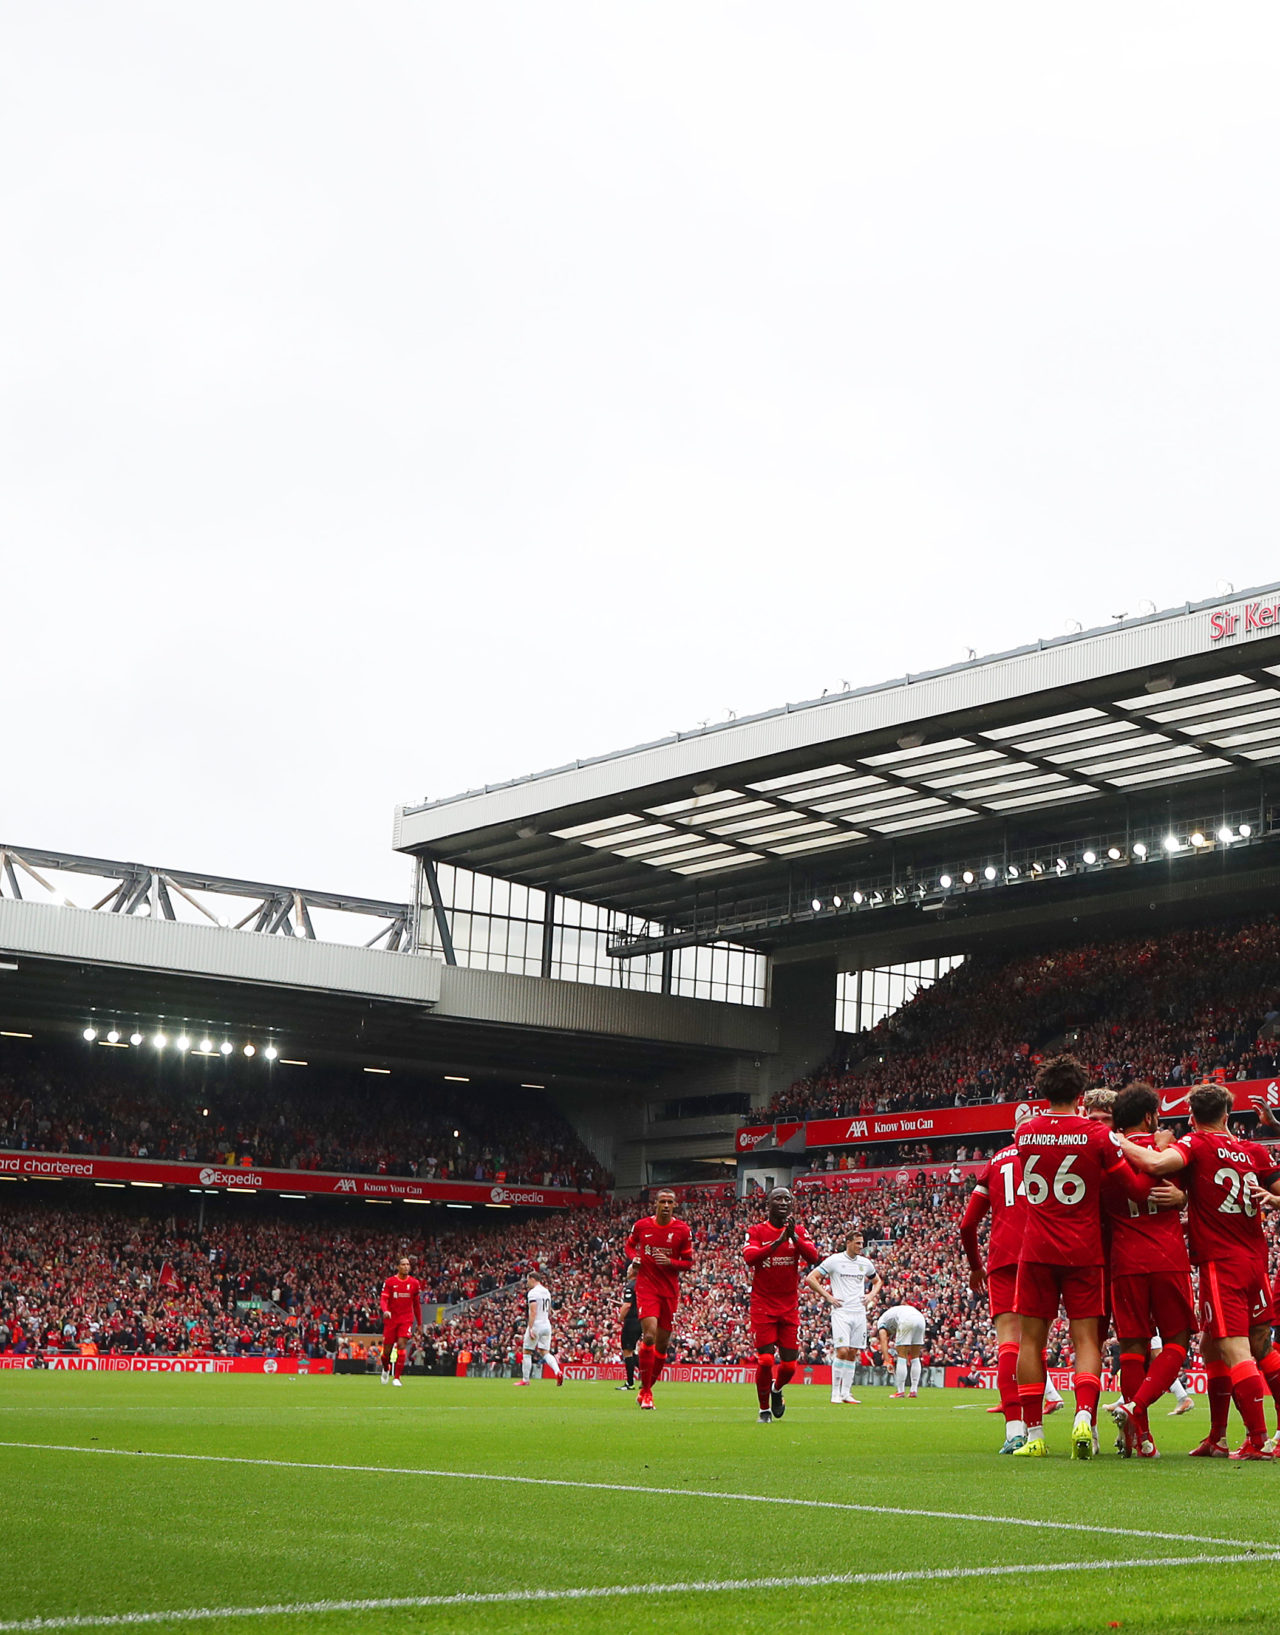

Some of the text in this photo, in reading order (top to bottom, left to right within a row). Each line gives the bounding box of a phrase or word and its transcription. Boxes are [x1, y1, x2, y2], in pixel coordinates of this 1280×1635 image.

[1210, 611, 1240, 640] Sir
[846, 1118, 933, 1138] AXA Know You Can
[1018, 1133, 1088, 1146] ALEXANDER-ARNOLD
[24, 1158, 93, 1175] chartered
[215, 1172, 262, 1185] Expedia
[1024, 1154, 1086, 1205] 66
[333, 1179, 422, 1194] AXA Know You Can
[504, 1190, 544, 1203] Expedia
[133, 1359, 211, 1372] REPORT
[214, 1360, 234, 1372] IT
[565, 1367, 595, 1381] STOP
[692, 1368, 743, 1383] REPORT
